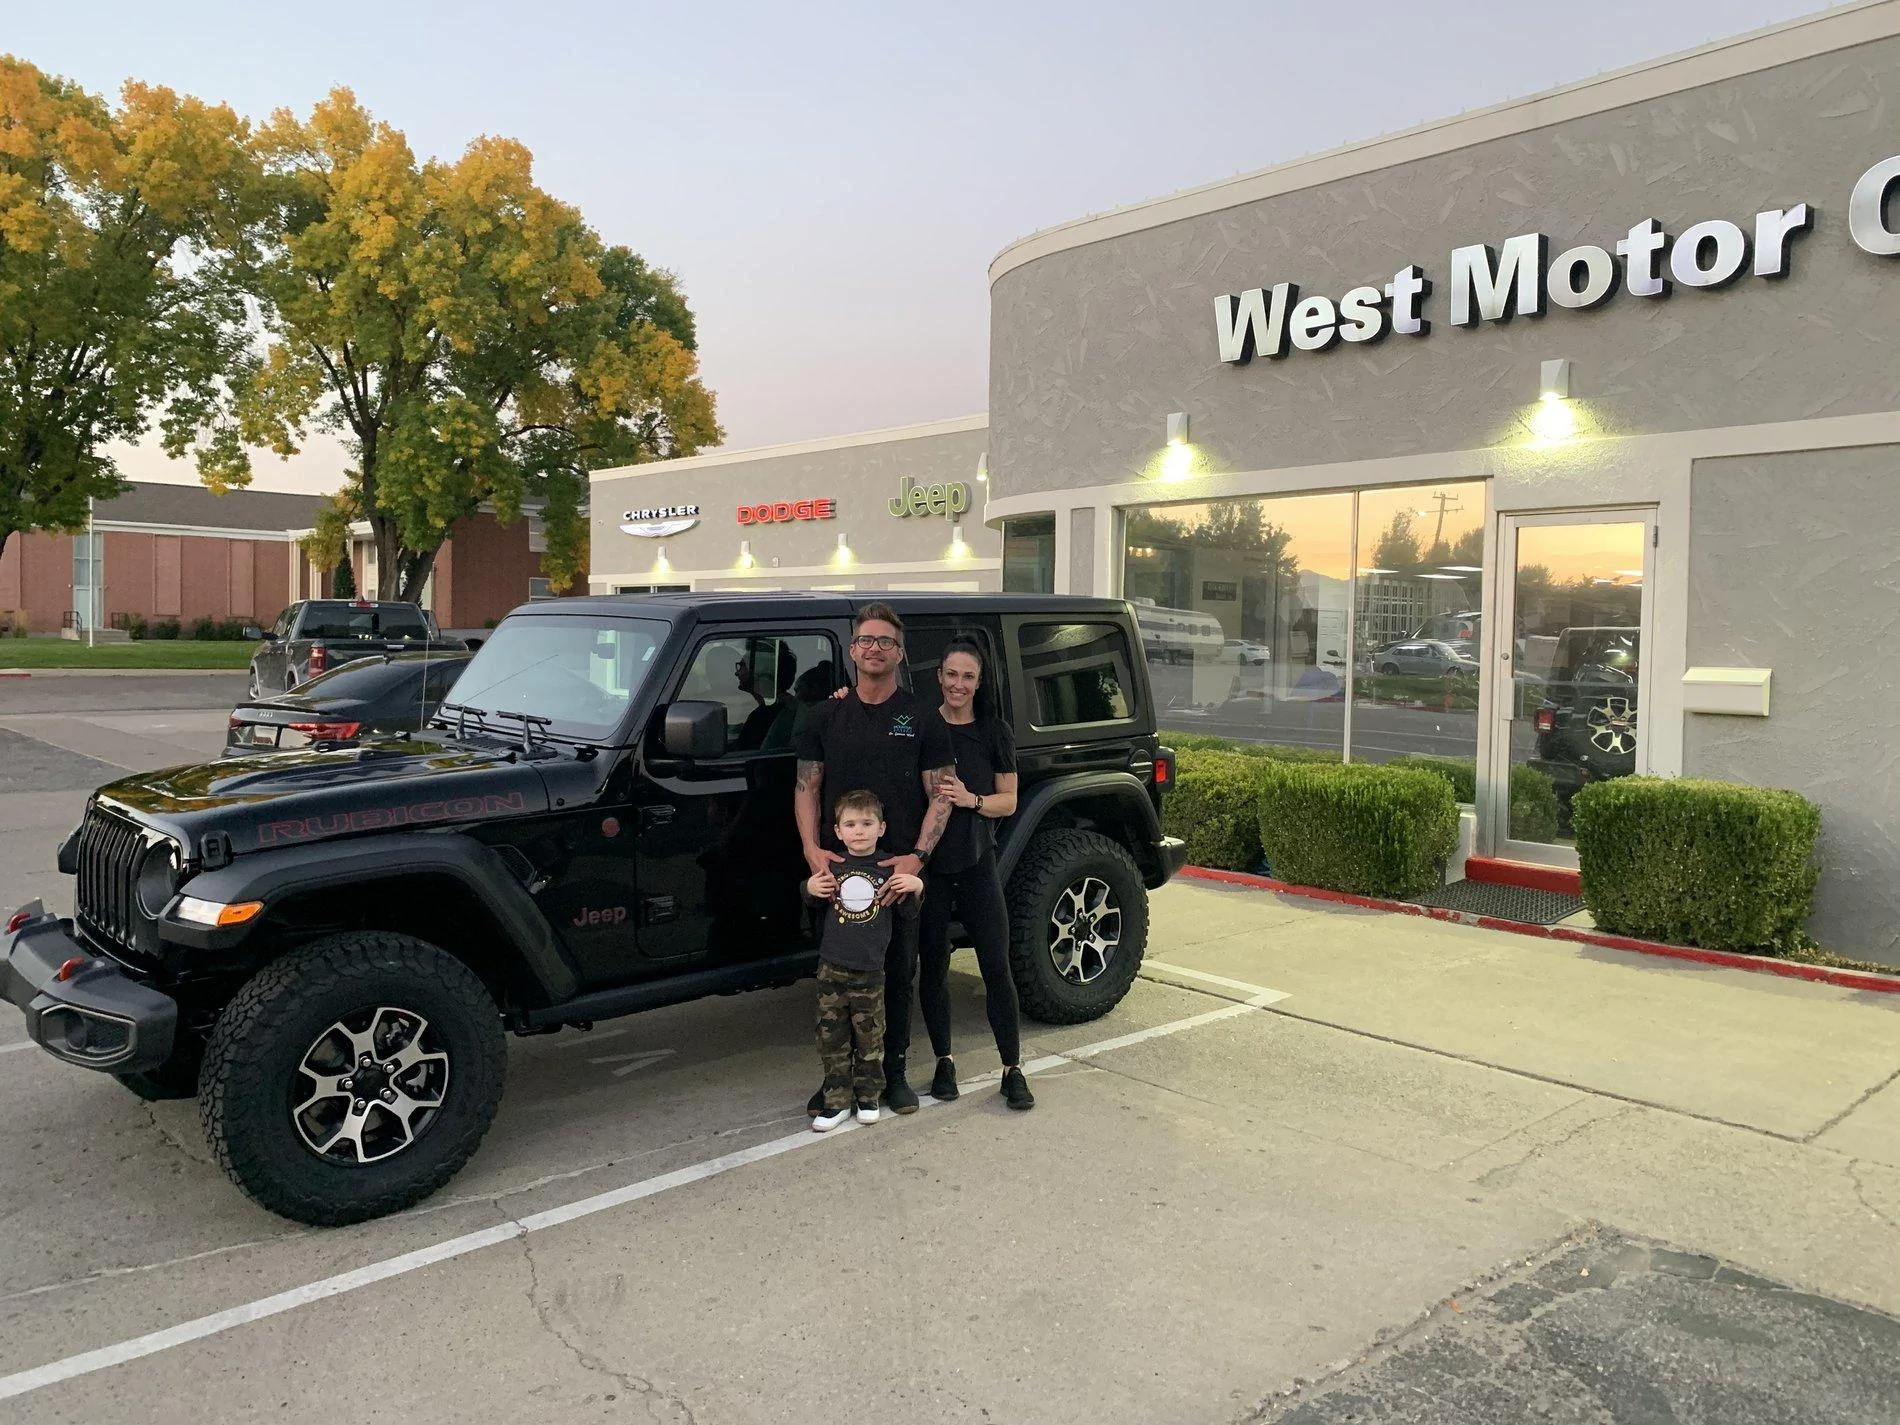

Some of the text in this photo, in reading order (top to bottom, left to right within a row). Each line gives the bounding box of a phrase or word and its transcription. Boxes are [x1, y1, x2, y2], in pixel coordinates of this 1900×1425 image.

[1214, 264, 1426, 363] West
[1451, 202, 1810, 327] Motor
[622, 504, 698, 522] CHRYSLER
[736, 498, 834, 525] DODGE
[887, 475, 968, 522] Jeep
[258, 791, 525, 848] RUBICON
[573, 906, 627, 928] Jeep
